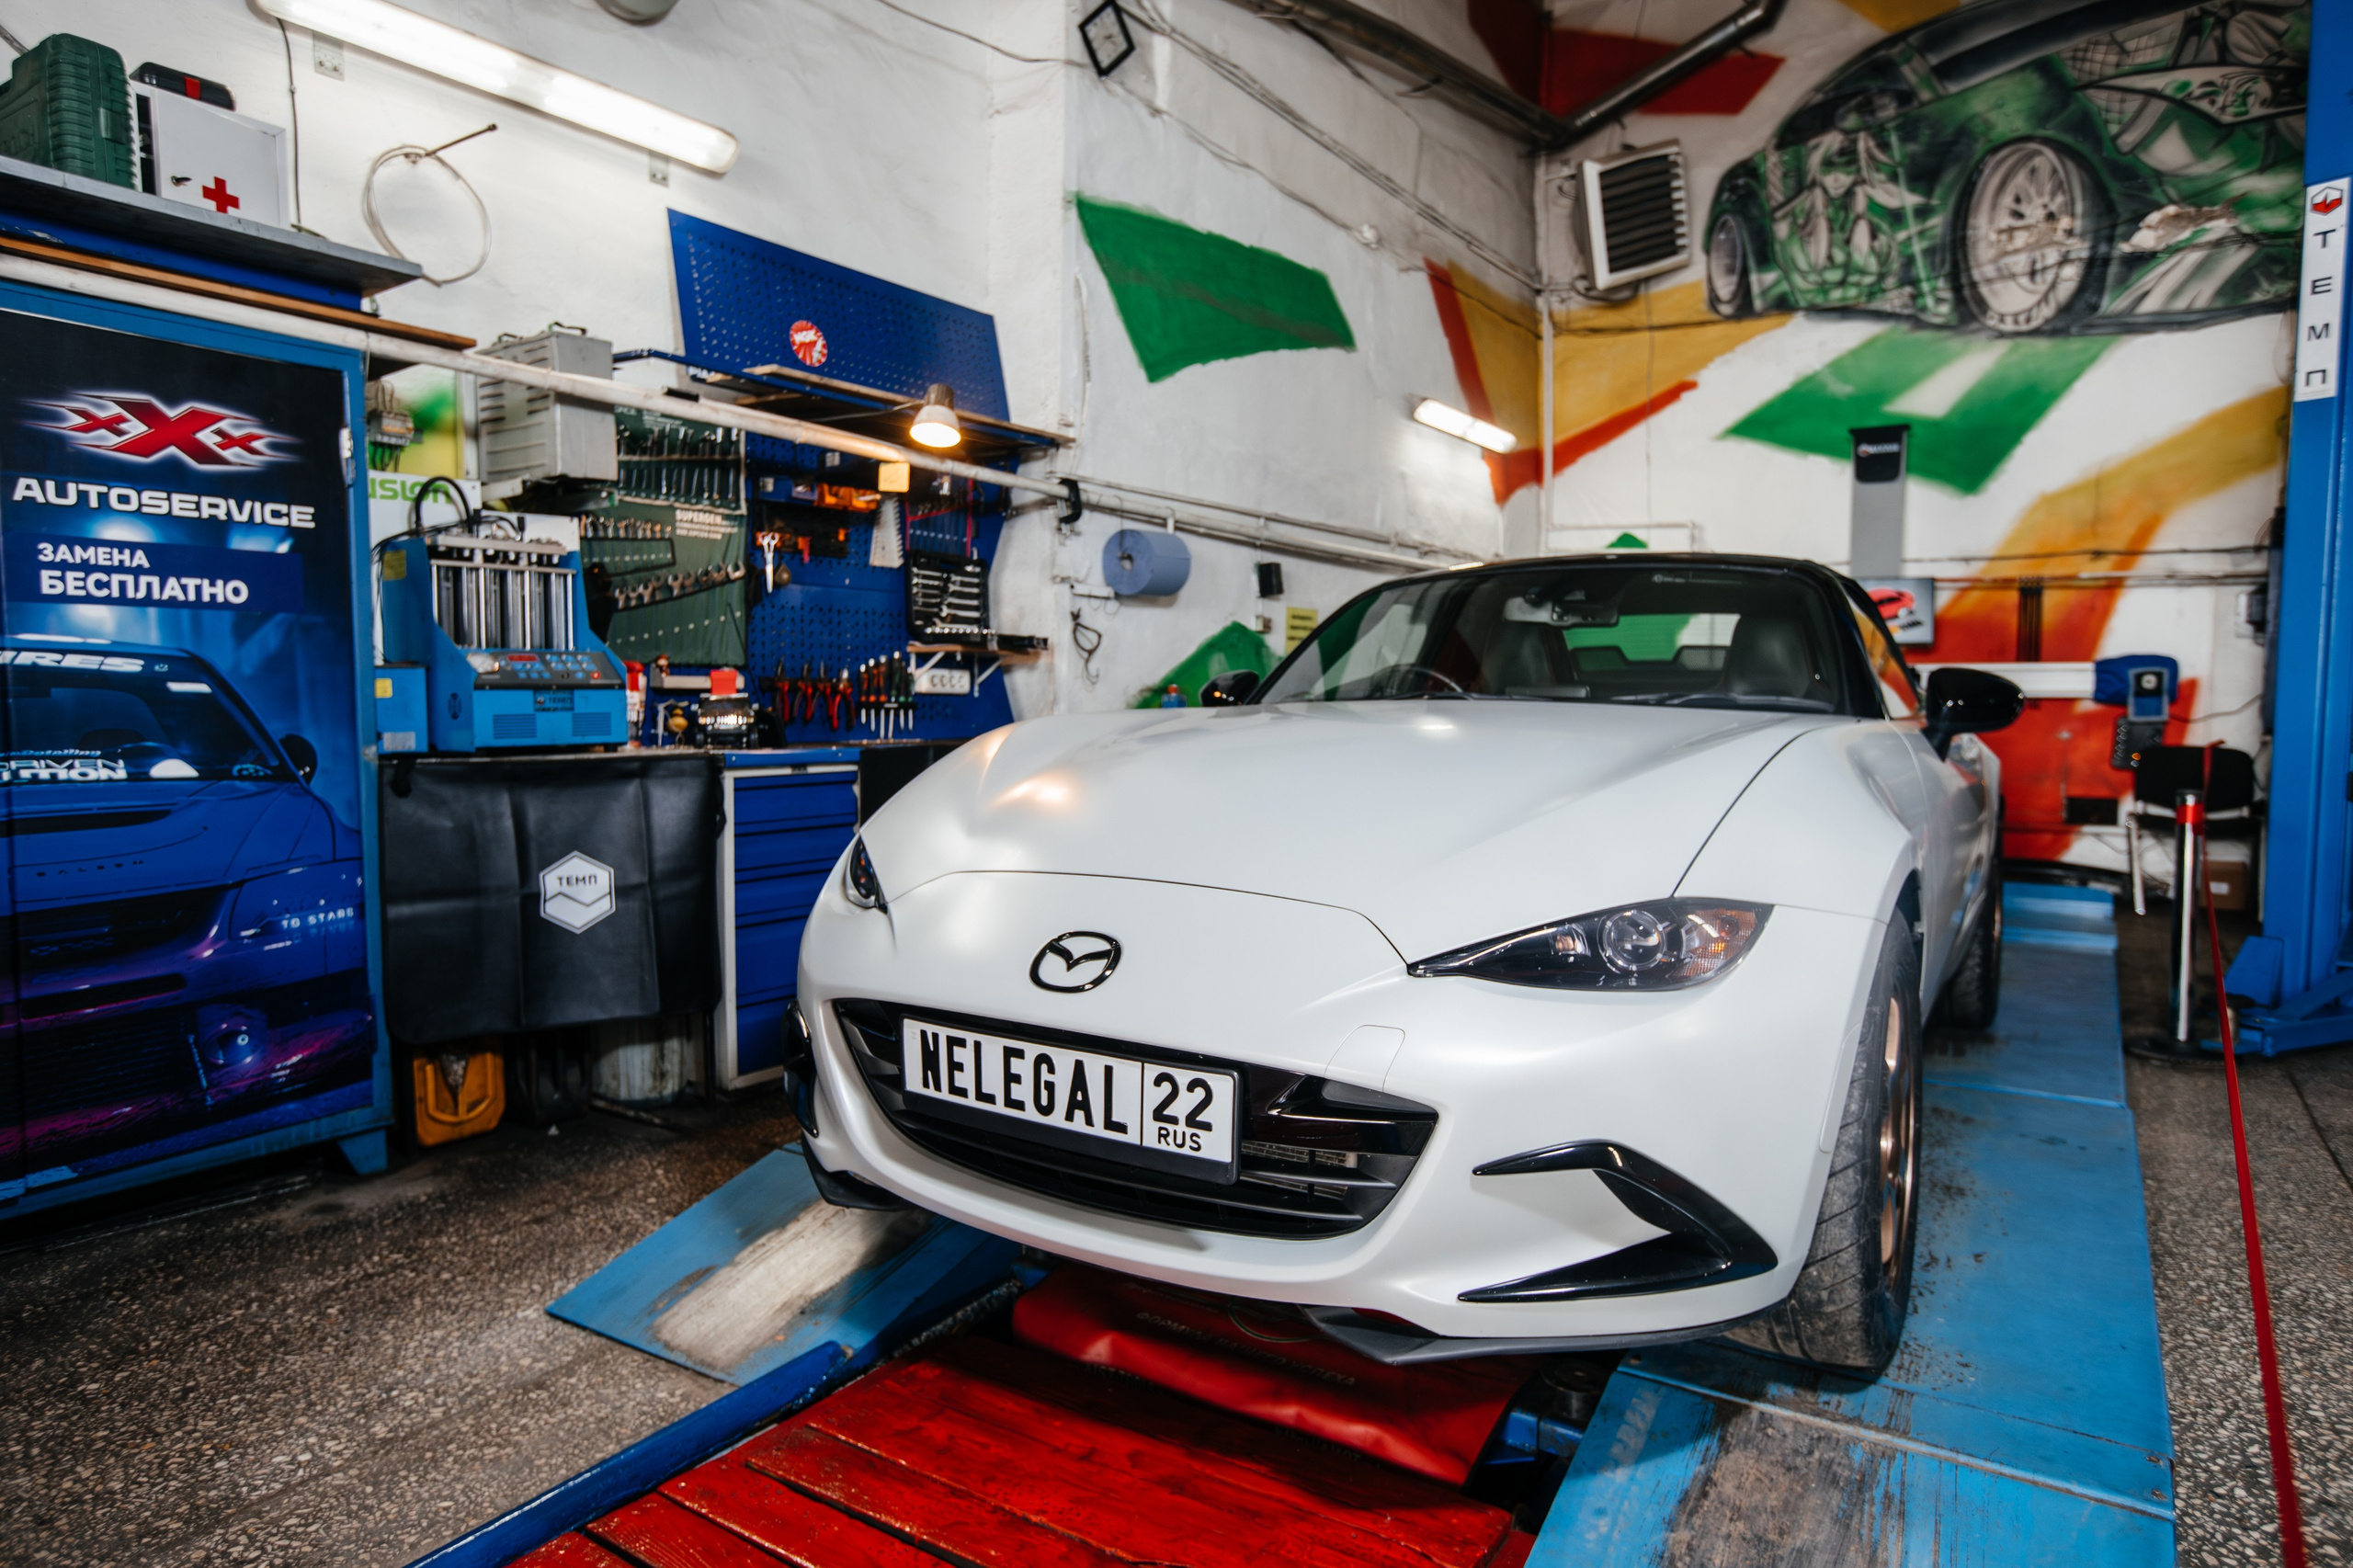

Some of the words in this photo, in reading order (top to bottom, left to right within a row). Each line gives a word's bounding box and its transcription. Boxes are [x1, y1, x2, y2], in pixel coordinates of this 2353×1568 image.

[2305, 229, 2336, 387] ТЕМП
[12, 477, 316, 529] AUTOSERVICE
[37, 542, 150, 568] ЗАМЕНА
[40, 569, 249, 605] БЕСПЛАТНО
[557, 873, 597, 887] ТЕМП
[920, 1028, 1129, 1135] NELEGAL
[1152, 1072, 1214, 1132] 22
[1157, 1126, 1202, 1153] RUS
